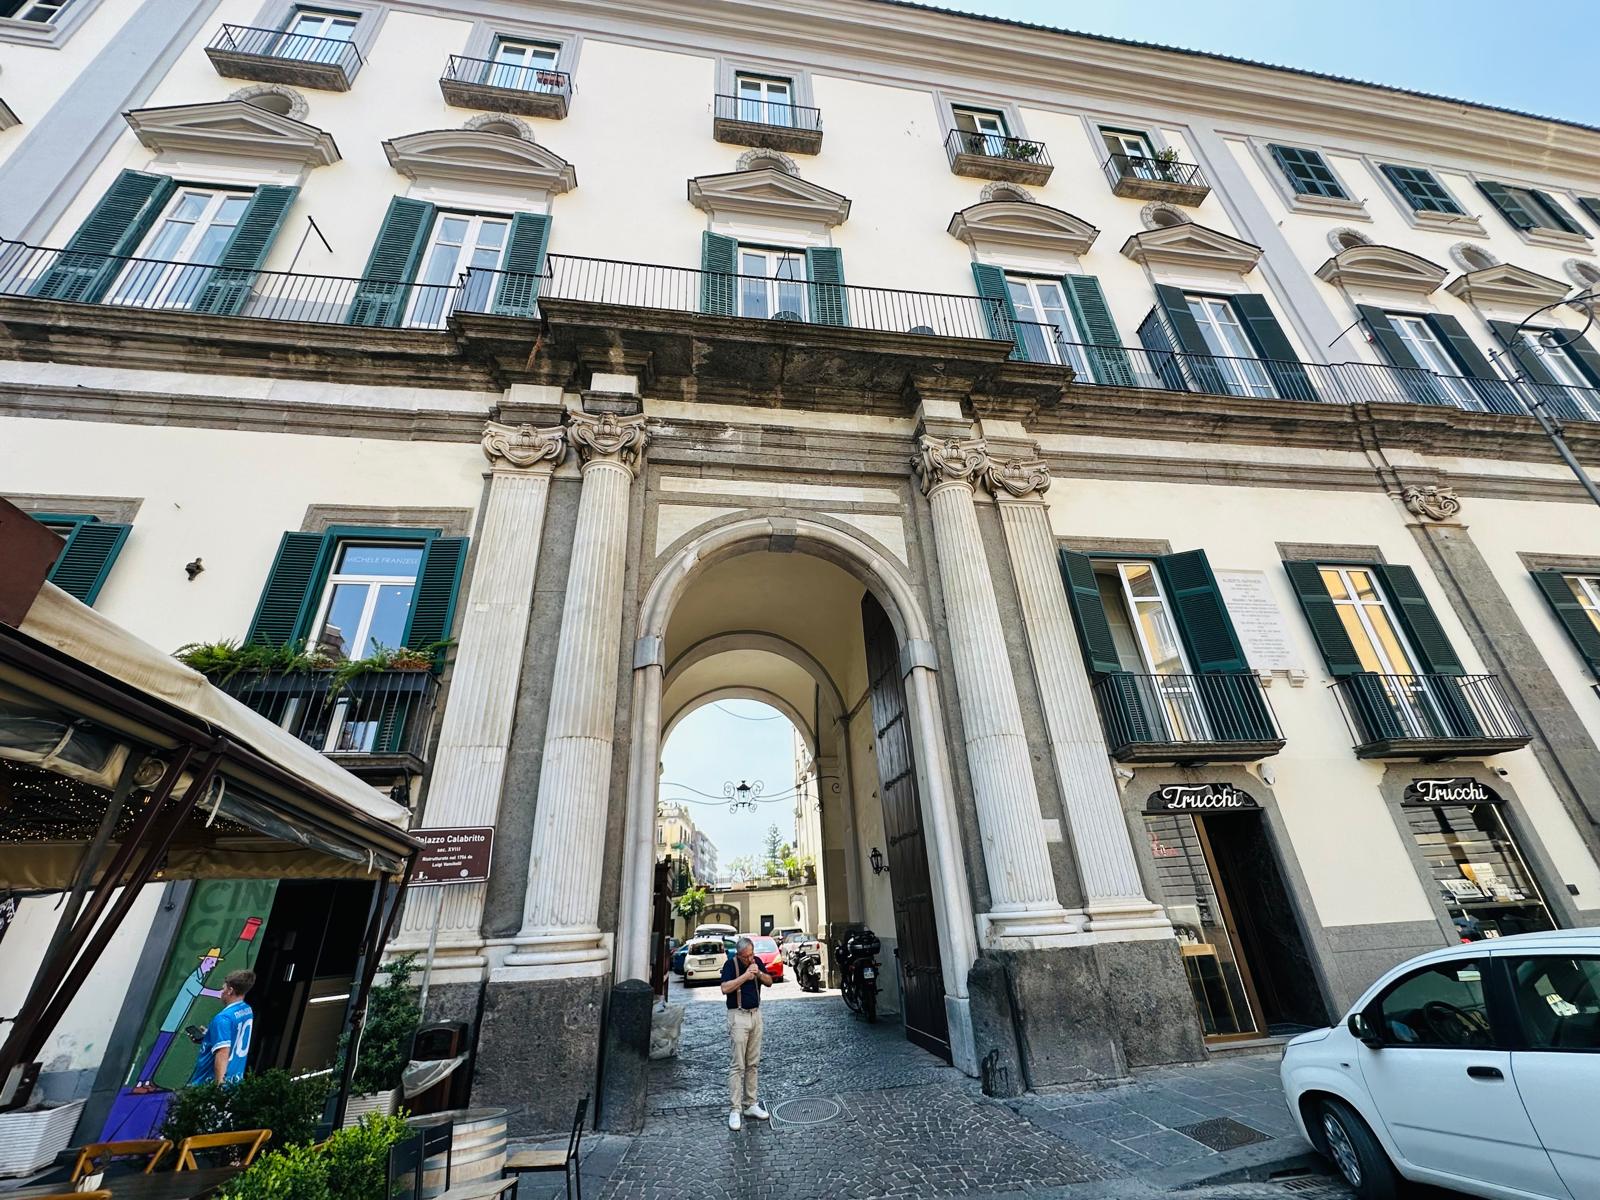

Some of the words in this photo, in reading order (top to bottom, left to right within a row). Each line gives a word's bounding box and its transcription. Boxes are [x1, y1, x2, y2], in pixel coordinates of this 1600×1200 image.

[1162, 784, 1242, 809] Trucchi
[1416, 778, 1489, 802] Trucchi
[446, 834, 485, 843] Calabritto
[228, 1018, 253, 1062] 10
